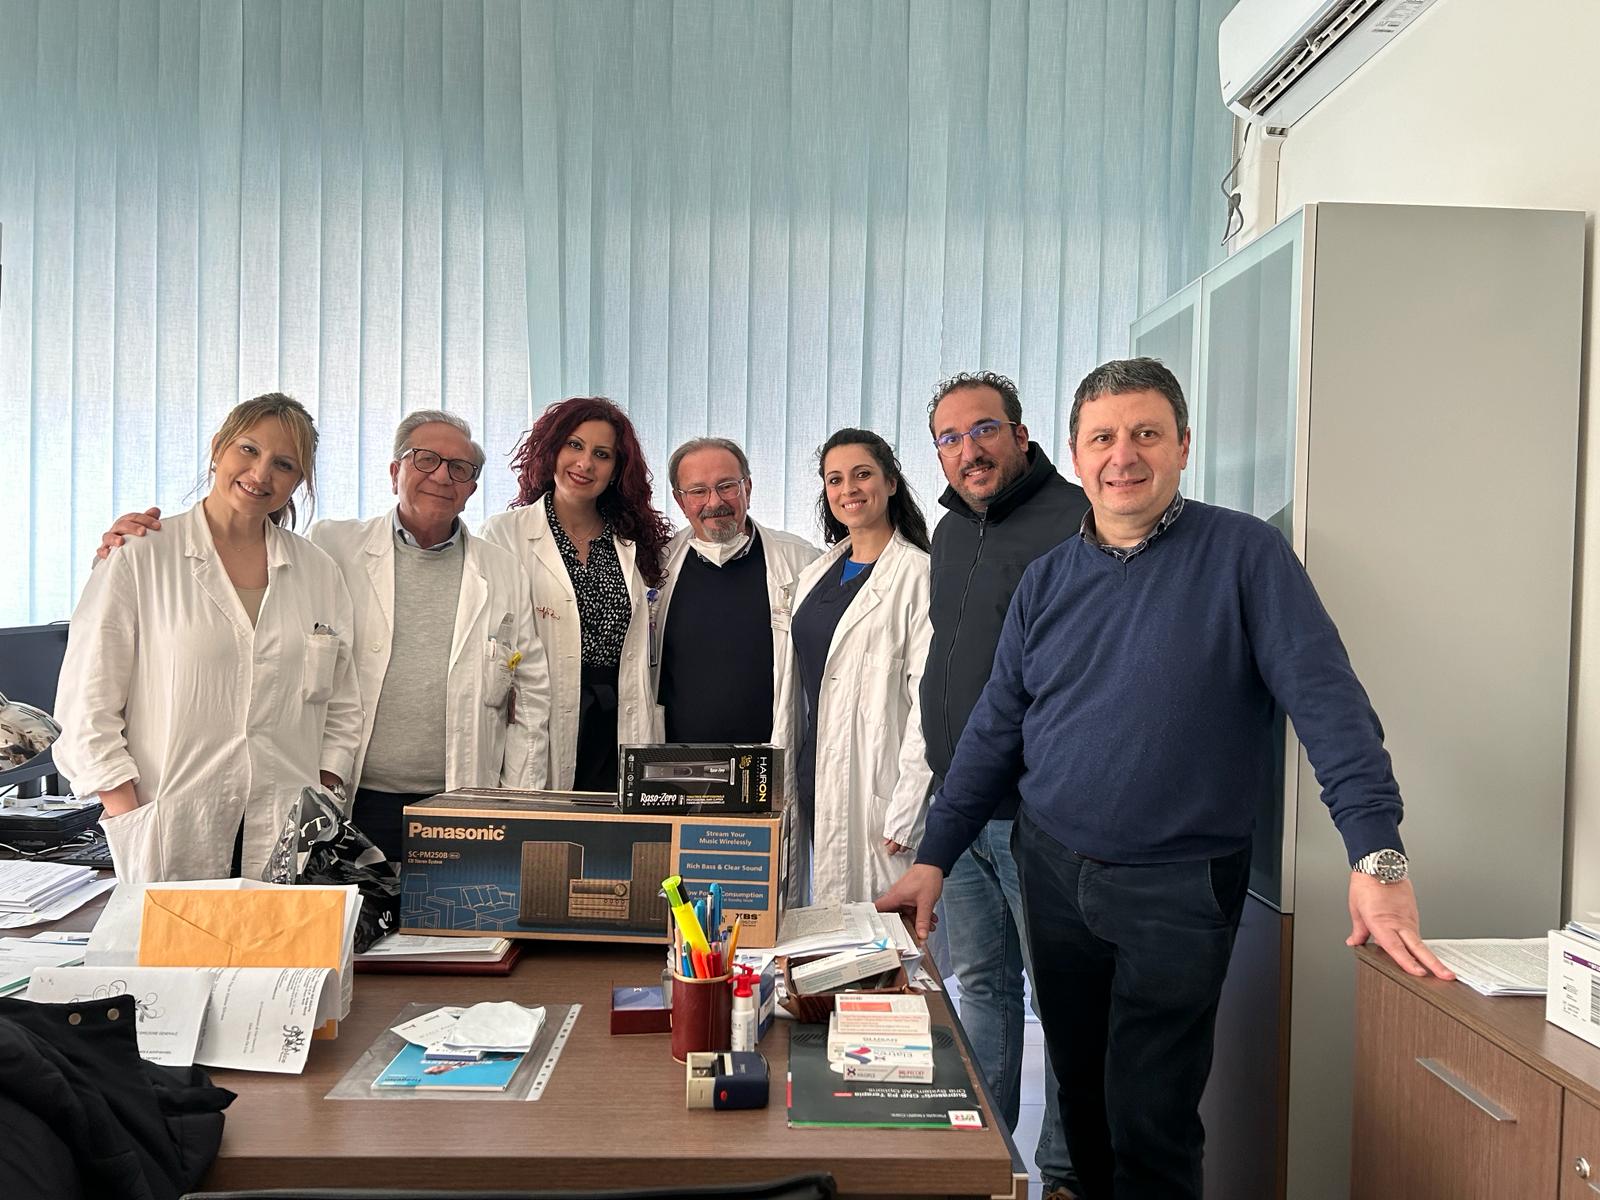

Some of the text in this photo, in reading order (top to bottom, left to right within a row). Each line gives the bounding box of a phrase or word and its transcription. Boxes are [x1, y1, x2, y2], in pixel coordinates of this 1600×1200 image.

[758, 756, 768, 803] HAIRON
[640, 792, 677, 803] Raso-Zero
[408, 822, 505, 841] Panasonic
[719, 838, 752, 847] Wirelessly
[408, 850, 448, 859] SC-PM250B
[724, 863, 740, 871] Clear
[742, 864, 763, 872] Sound
